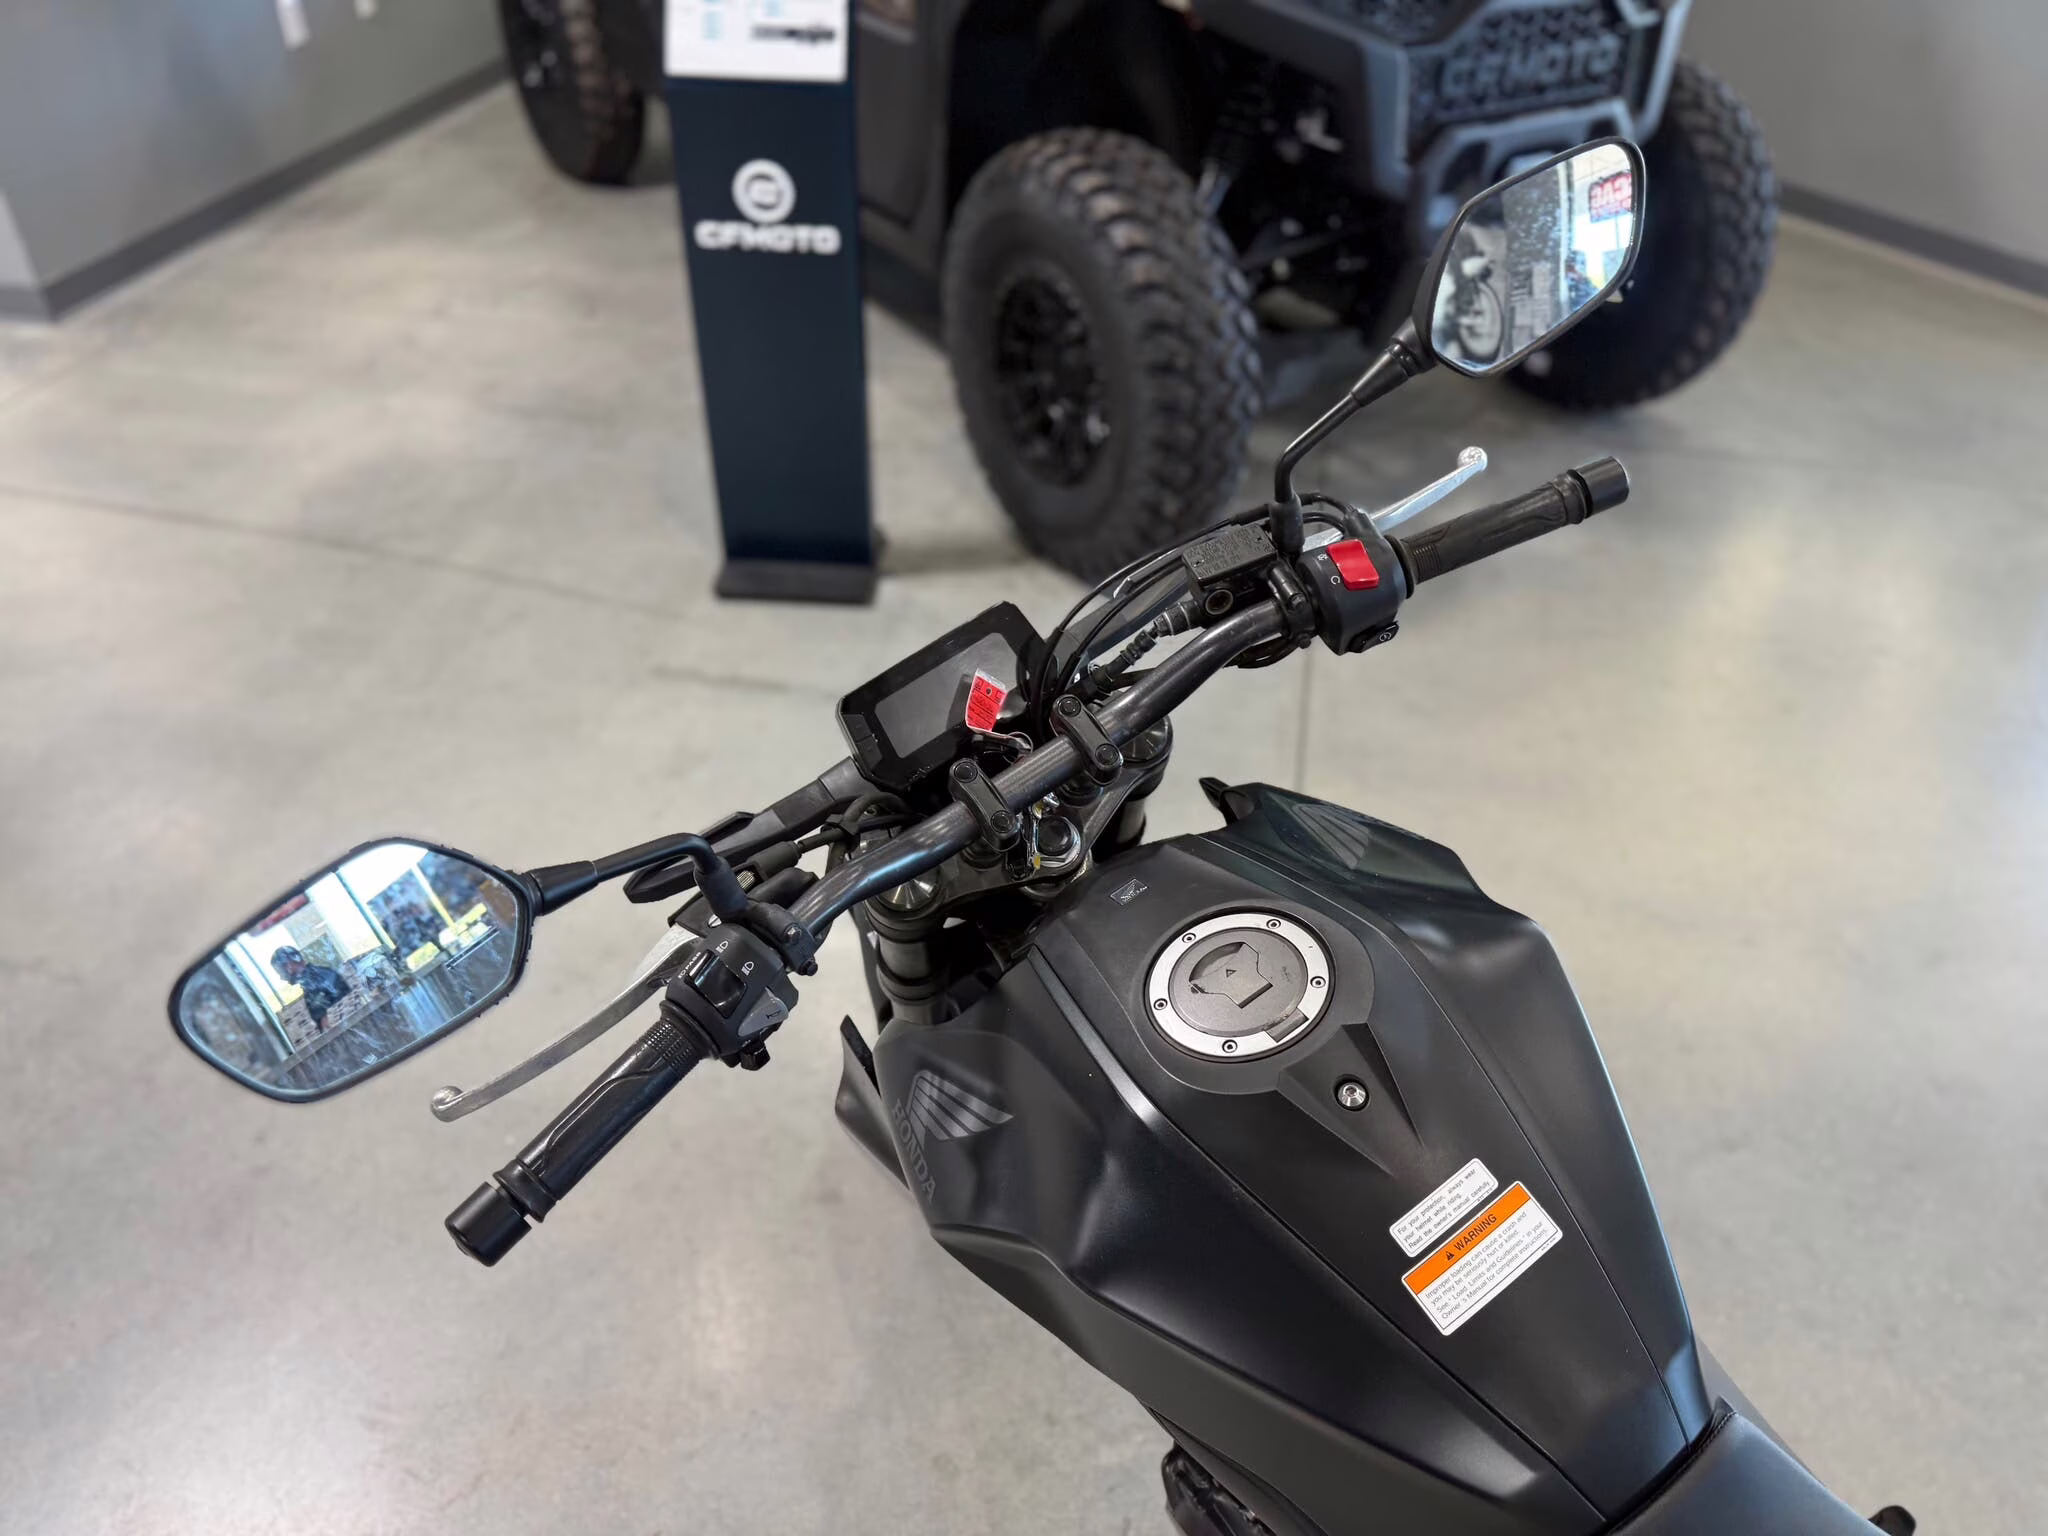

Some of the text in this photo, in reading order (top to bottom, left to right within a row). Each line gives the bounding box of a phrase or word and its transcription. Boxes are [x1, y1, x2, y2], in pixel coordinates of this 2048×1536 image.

[693, 218, 842, 255] CFMOTO
[891, 1099, 937, 1205] HONDA
[1397, 1225, 1407, 1235] For
[1408, 1215, 1420, 1227] your
[1447, 1179, 1464, 1194] always
[1464, 1169, 1476, 1180] wear
[1403, 1231, 1415, 1243] your
[1415, 1216, 1433, 1232] helmet
[1433, 1205, 1446, 1217] while
[1408, 1235, 1423, 1249] Read
[1423, 1228, 1433, 1237] the
[1452, 1196, 1470, 1213] manual
[1425, 1277, 1451, 1299] Improper
[1450, 1260, 1473, 1279] loading
[1471, 1250, 1483, 1262] can
[1481, 1237, 1498, 1253] cause
[1502, 1221, 1517, 1235] crash
[1517, 1211, 1527, 1223] and
[1453, 1214, 1497, 1251] WARNING
[1431, 1294, 1443, 1307] you
[1442, 1284, 1456, 1296] may
[1454, 1277, 1464, 1286] be
[1463, 1258, 1488, 1279] seriously
[1486, 1247, 1499, 1258] hurt
[1498, 1241, 1504, 1249] or
[1436, 1302, 1450, 1313] See
[1468, 1271, 1486, 1287] Limits
[1486, 1261, 1497, 1273] and
[1532, 1221, 1543, 1234] your
[1466, 1279, 1488, 1299] Manual
[1486, 1273, 1496, 1282] for
[1495, 1253, 1519, 1275] complete
